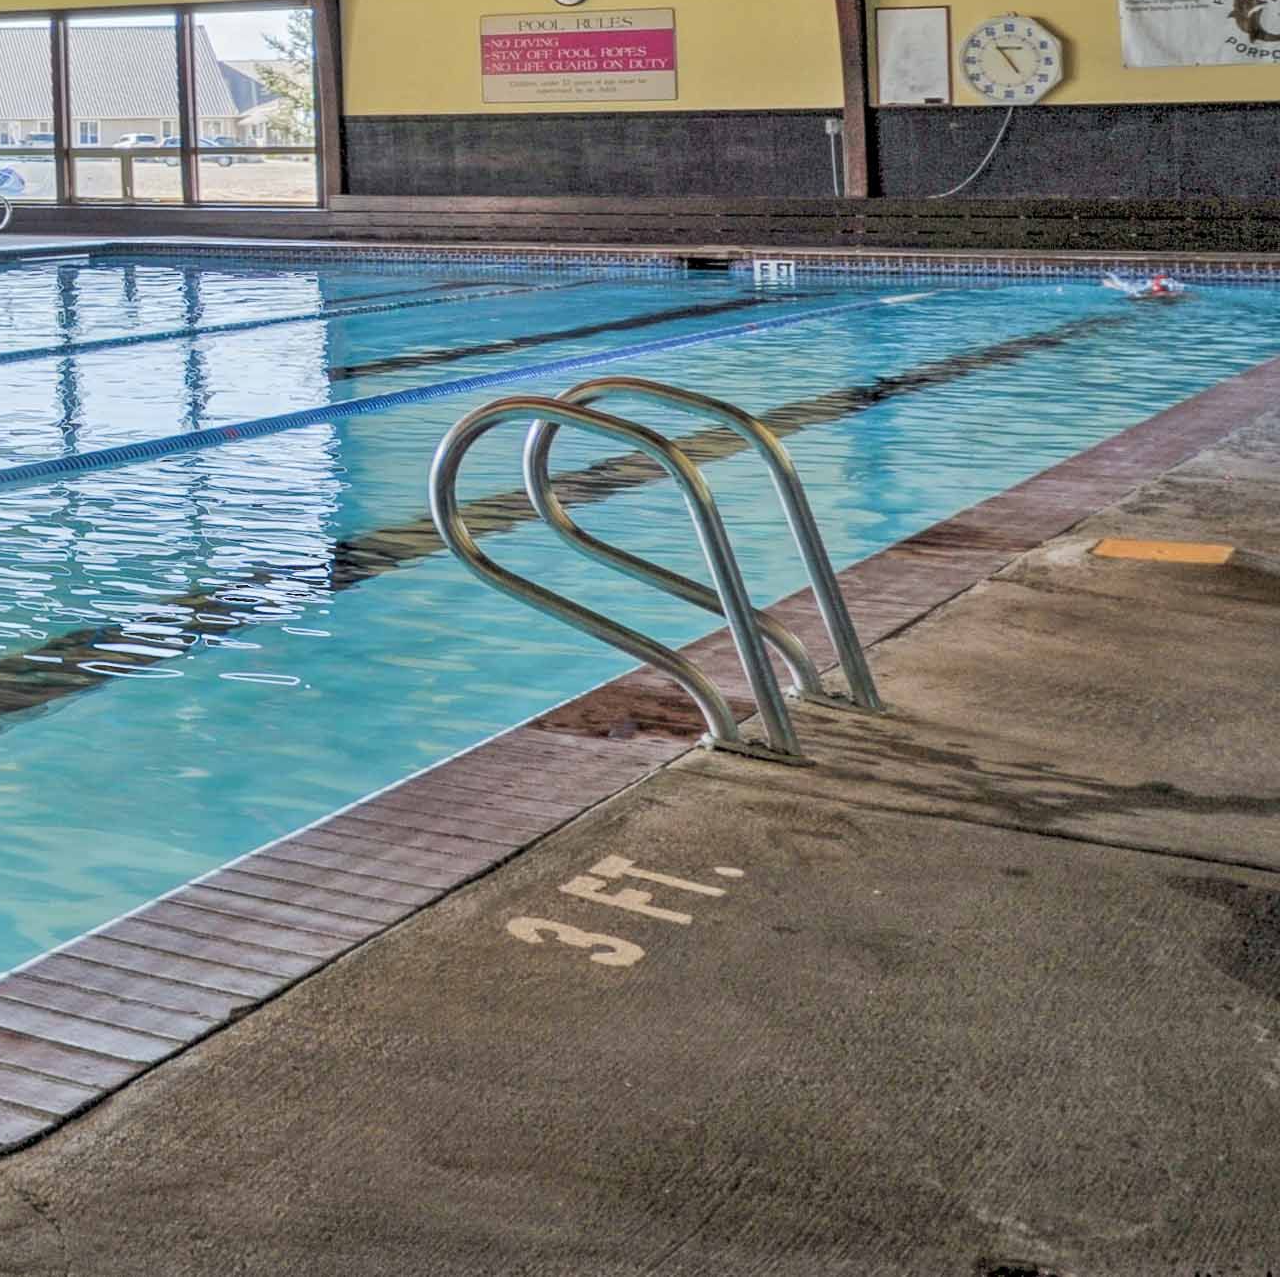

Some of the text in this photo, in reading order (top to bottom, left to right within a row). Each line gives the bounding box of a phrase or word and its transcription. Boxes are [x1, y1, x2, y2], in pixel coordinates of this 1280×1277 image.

[517, 16, 633, 32] POOL RULES
[514, 37, 560, 48] DIVING
[526, 49, 554, 60] OFF
[558, 48, 597, 59] POOL
[601, 46, 648, 58] ROPES
[516, 61, 545, 72] LIFE
[549, 60, 599, 71] GUARD
[603, 59, 623, 69] ON
[629, 58, 669, 69] DUTY
[776, 262, 793, 277] FT
[506, 916, 646, 968] 3
